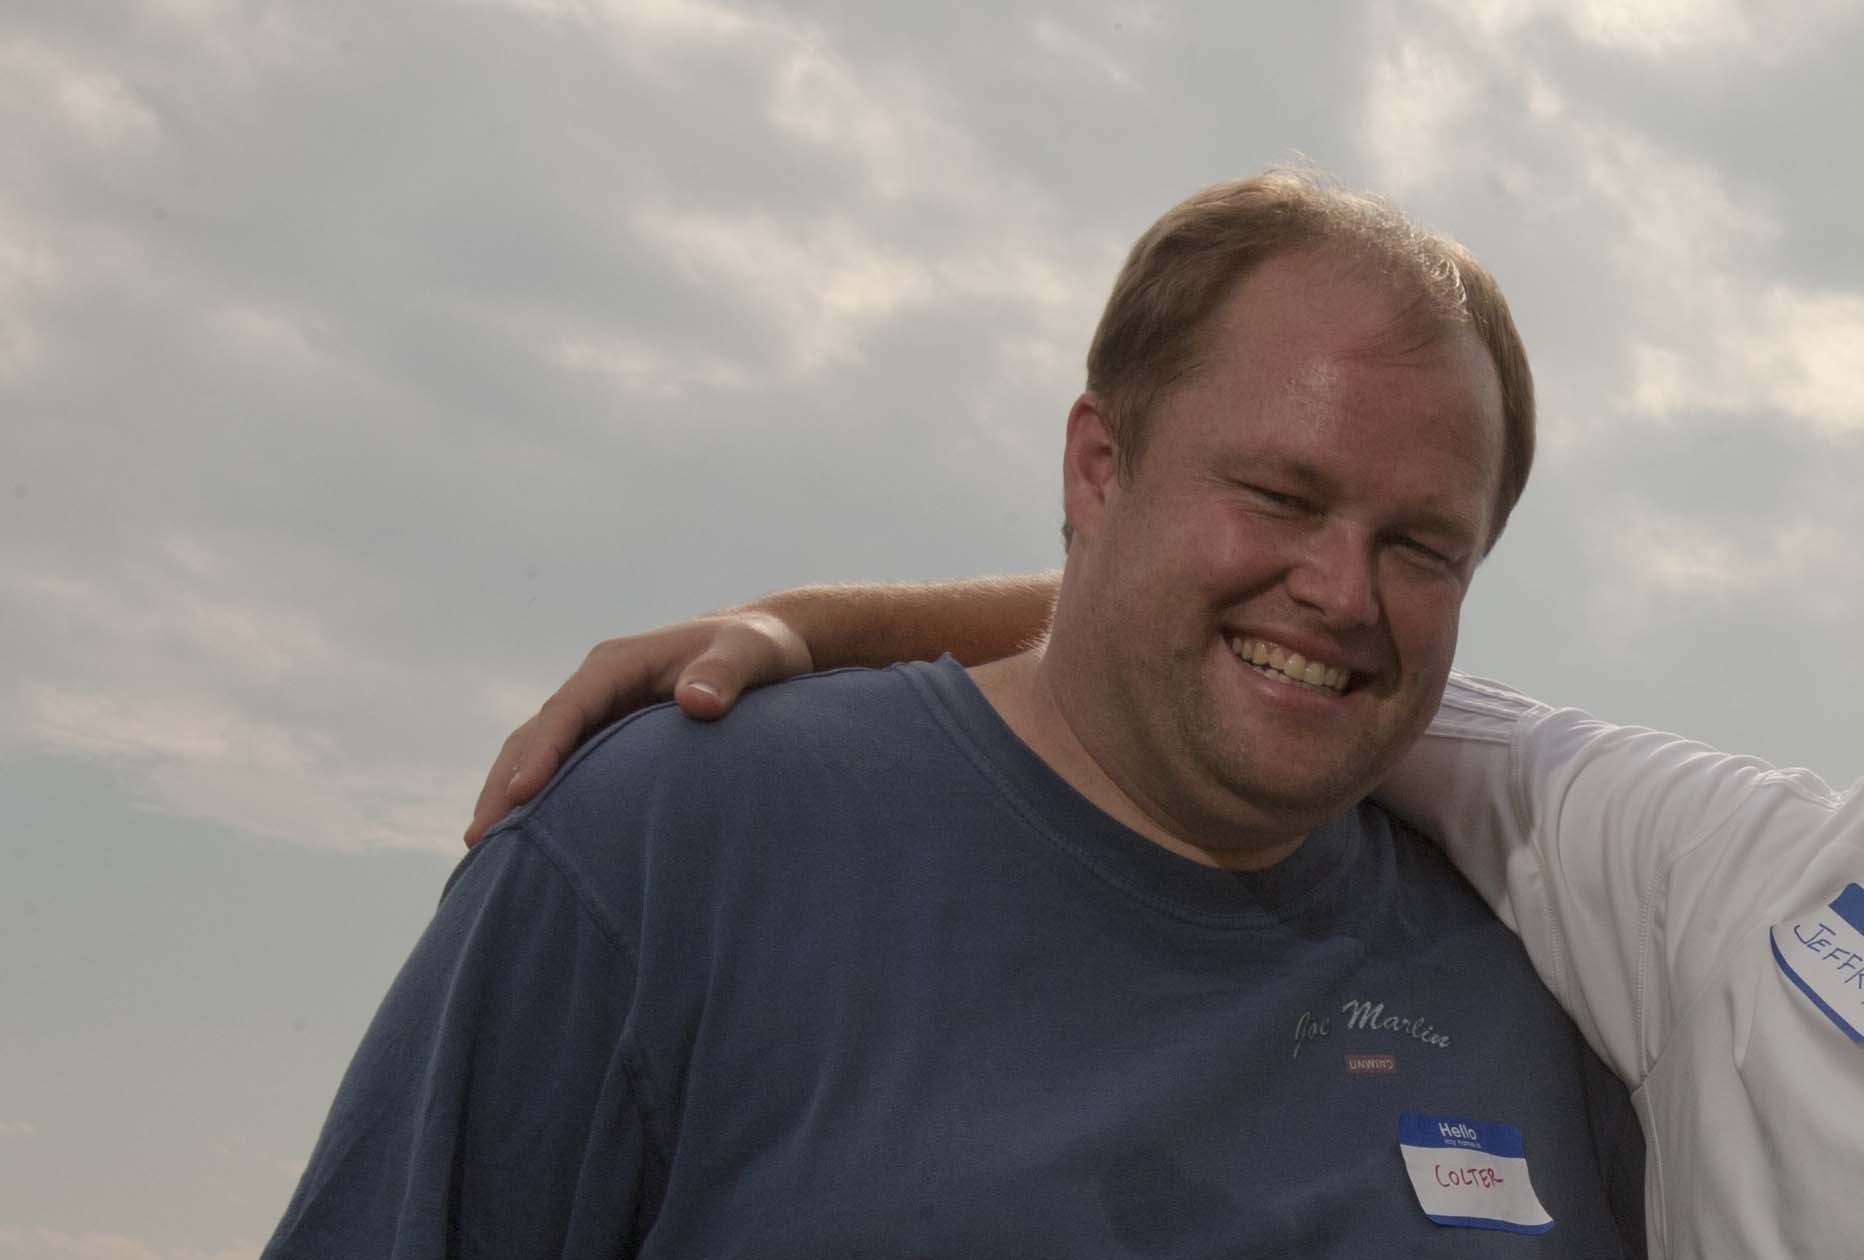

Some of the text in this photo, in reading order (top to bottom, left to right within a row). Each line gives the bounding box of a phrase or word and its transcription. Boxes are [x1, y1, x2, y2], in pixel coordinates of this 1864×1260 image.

[1342, 999, 1452, 1049] Marlin
[1438, 1121, 1477, 1141] Hello
[1435, 1164, 1504, 1188] COLTER
